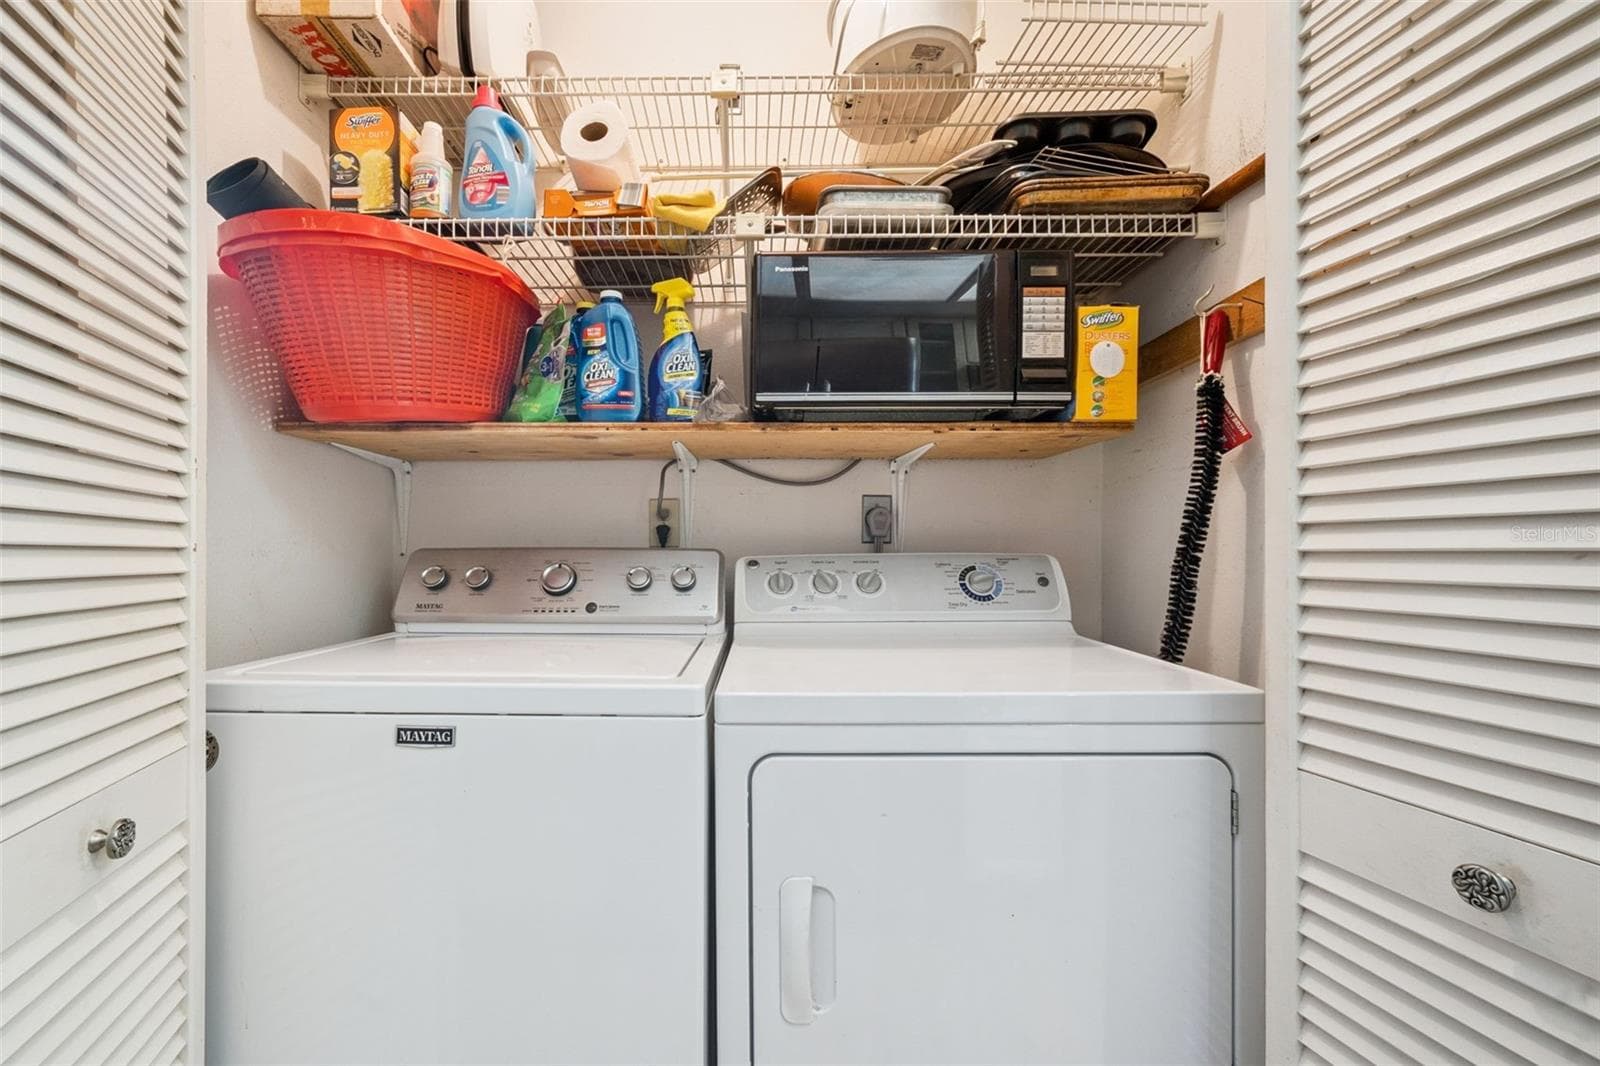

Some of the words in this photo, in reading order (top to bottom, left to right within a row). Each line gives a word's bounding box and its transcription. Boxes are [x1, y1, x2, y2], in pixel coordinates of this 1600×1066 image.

[346, 114, 381, 128] Swiffer
[340, 131, 365, 140] HEAVY
[774, 265, 809, 273] Panasonic
[1082, 311, 1123, 328] Swiffer
[1085, 331, 1131, 340] DUSTERS
[673, 353, 690, 364] OXI
[590, 361, 608, 373] OXI
[666, 361, 696, 373] CLEAN
[584, 369, 613, 382] CLEAN
[399, 730, 451, 743] MAYTAG
